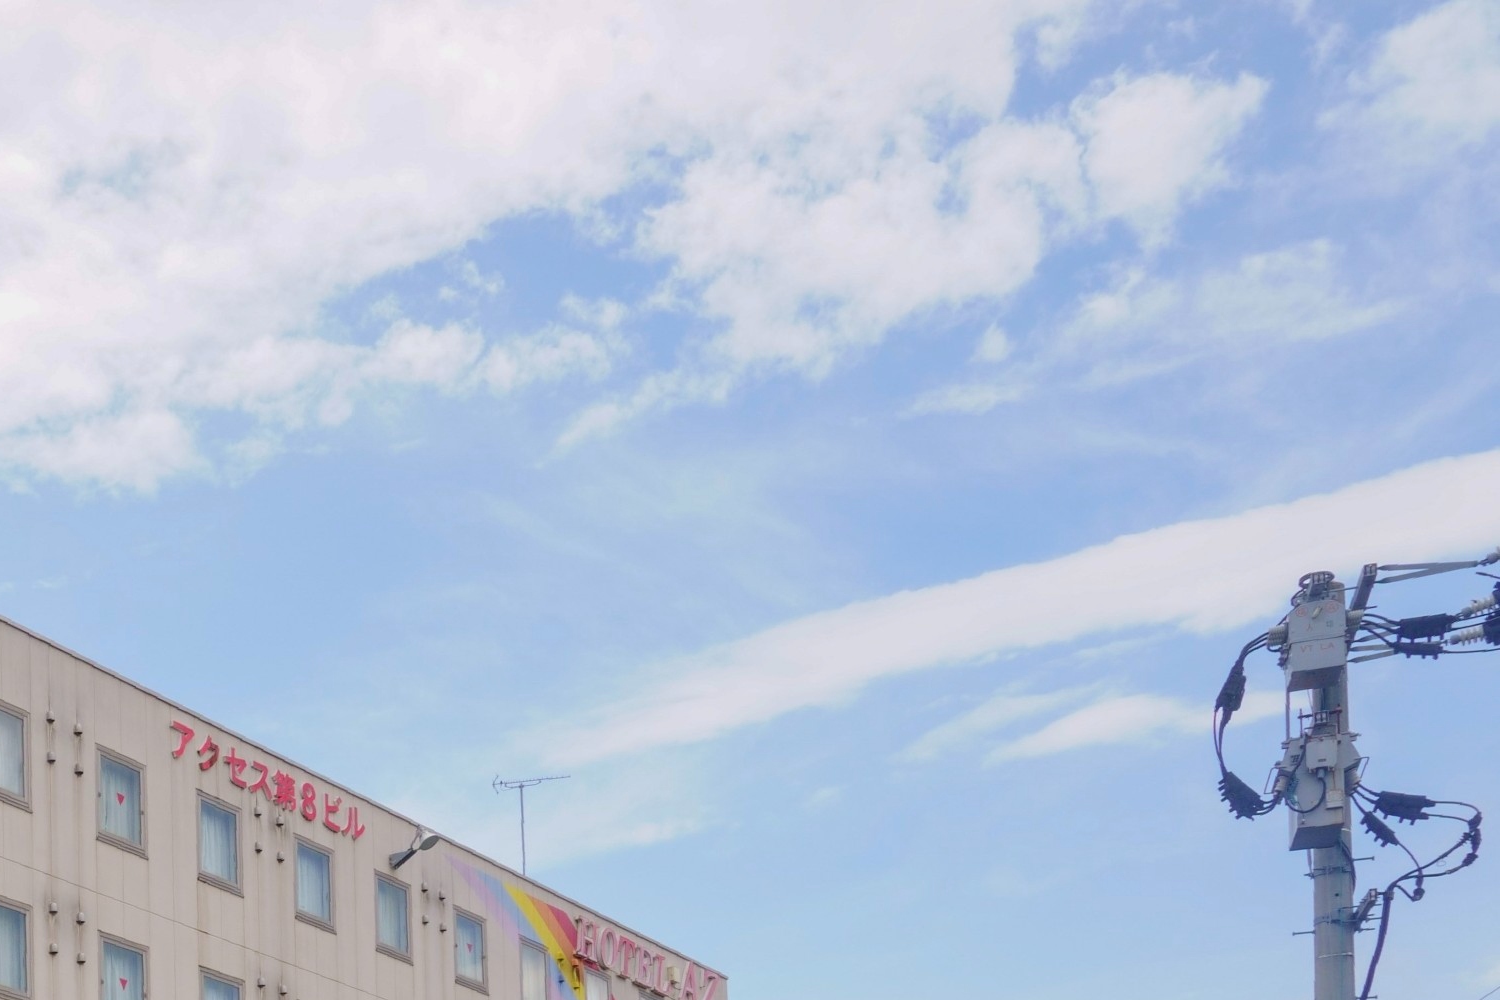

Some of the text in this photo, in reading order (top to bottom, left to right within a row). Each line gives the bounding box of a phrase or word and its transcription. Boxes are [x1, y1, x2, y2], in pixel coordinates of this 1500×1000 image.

[170, 720, 366, 841] アクセス第8ビル
[575, 915, 673, 998] HOTEL
